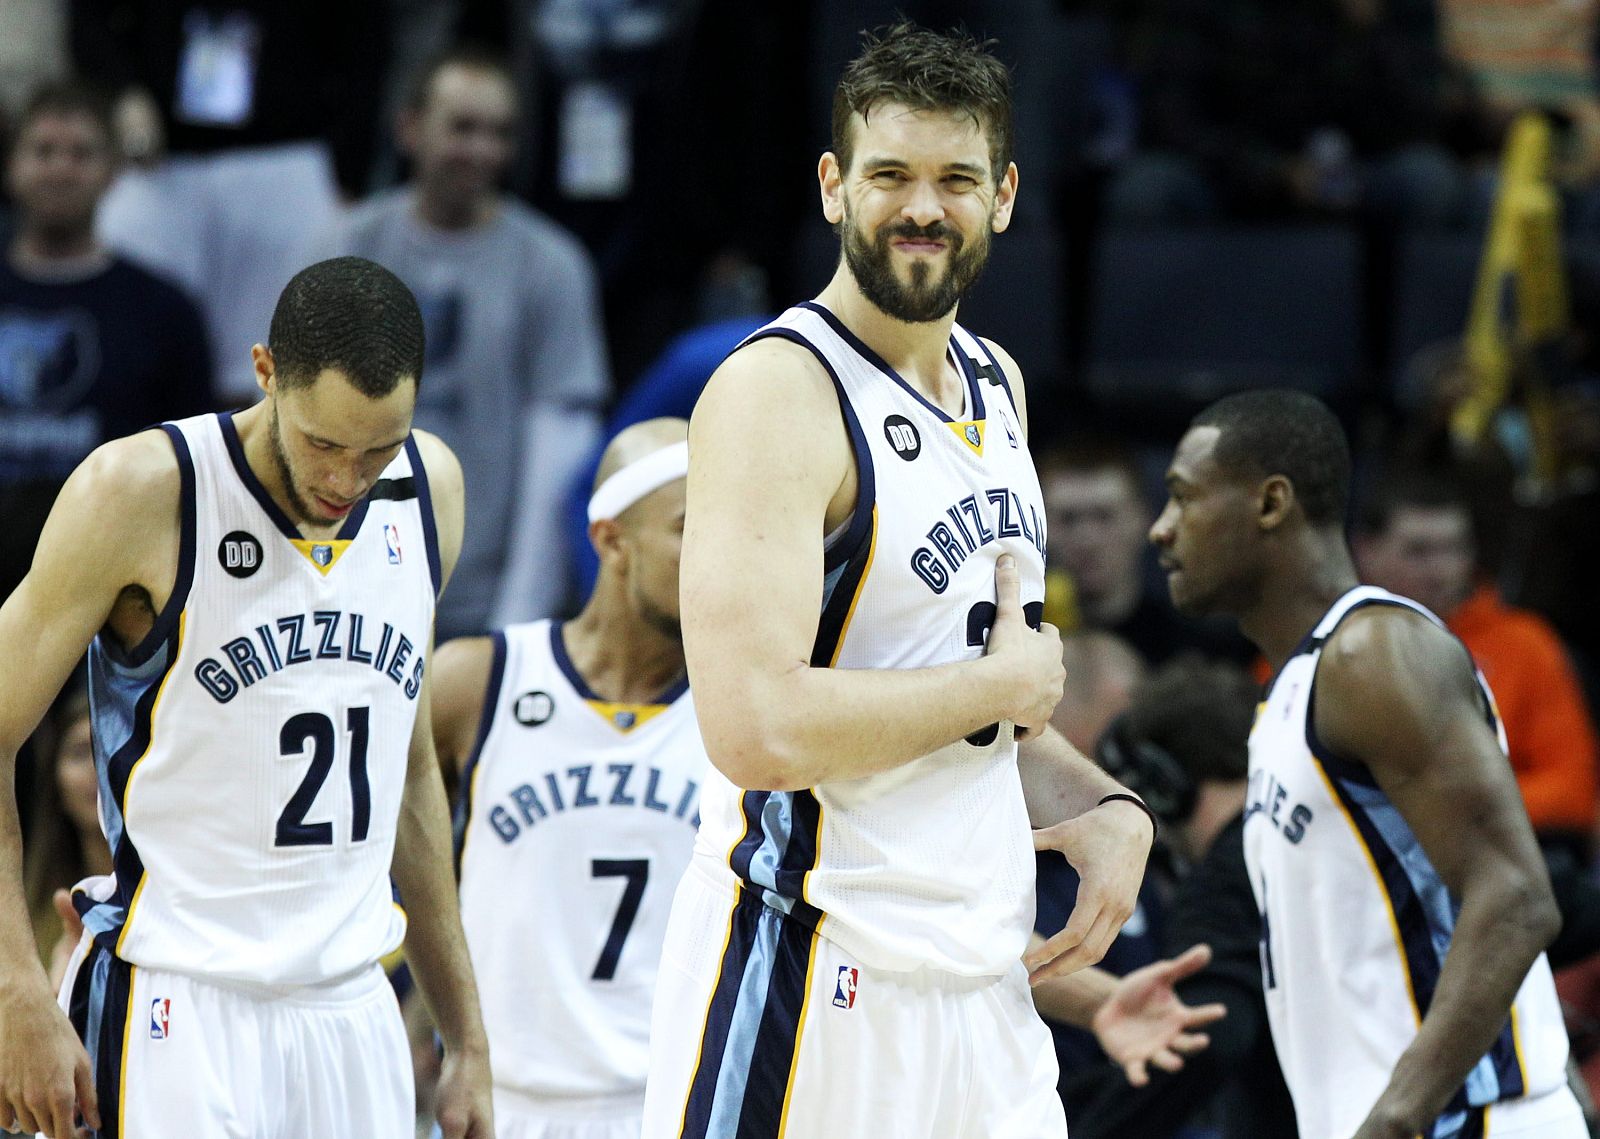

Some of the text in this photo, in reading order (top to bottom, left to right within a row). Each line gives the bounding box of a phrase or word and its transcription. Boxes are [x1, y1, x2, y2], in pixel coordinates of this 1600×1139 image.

[886, 424, 918, 452] DD
[224, 541, 257, 568] DD
[910, 487, 1047, 595] GRIZZLI
[194, 610, 424, 704] GRIZZLIES
[274, 706, 371, 847] 21
[488, 763, 702, 844] GRIZZLI
[591, 859, 649, 980] 7
